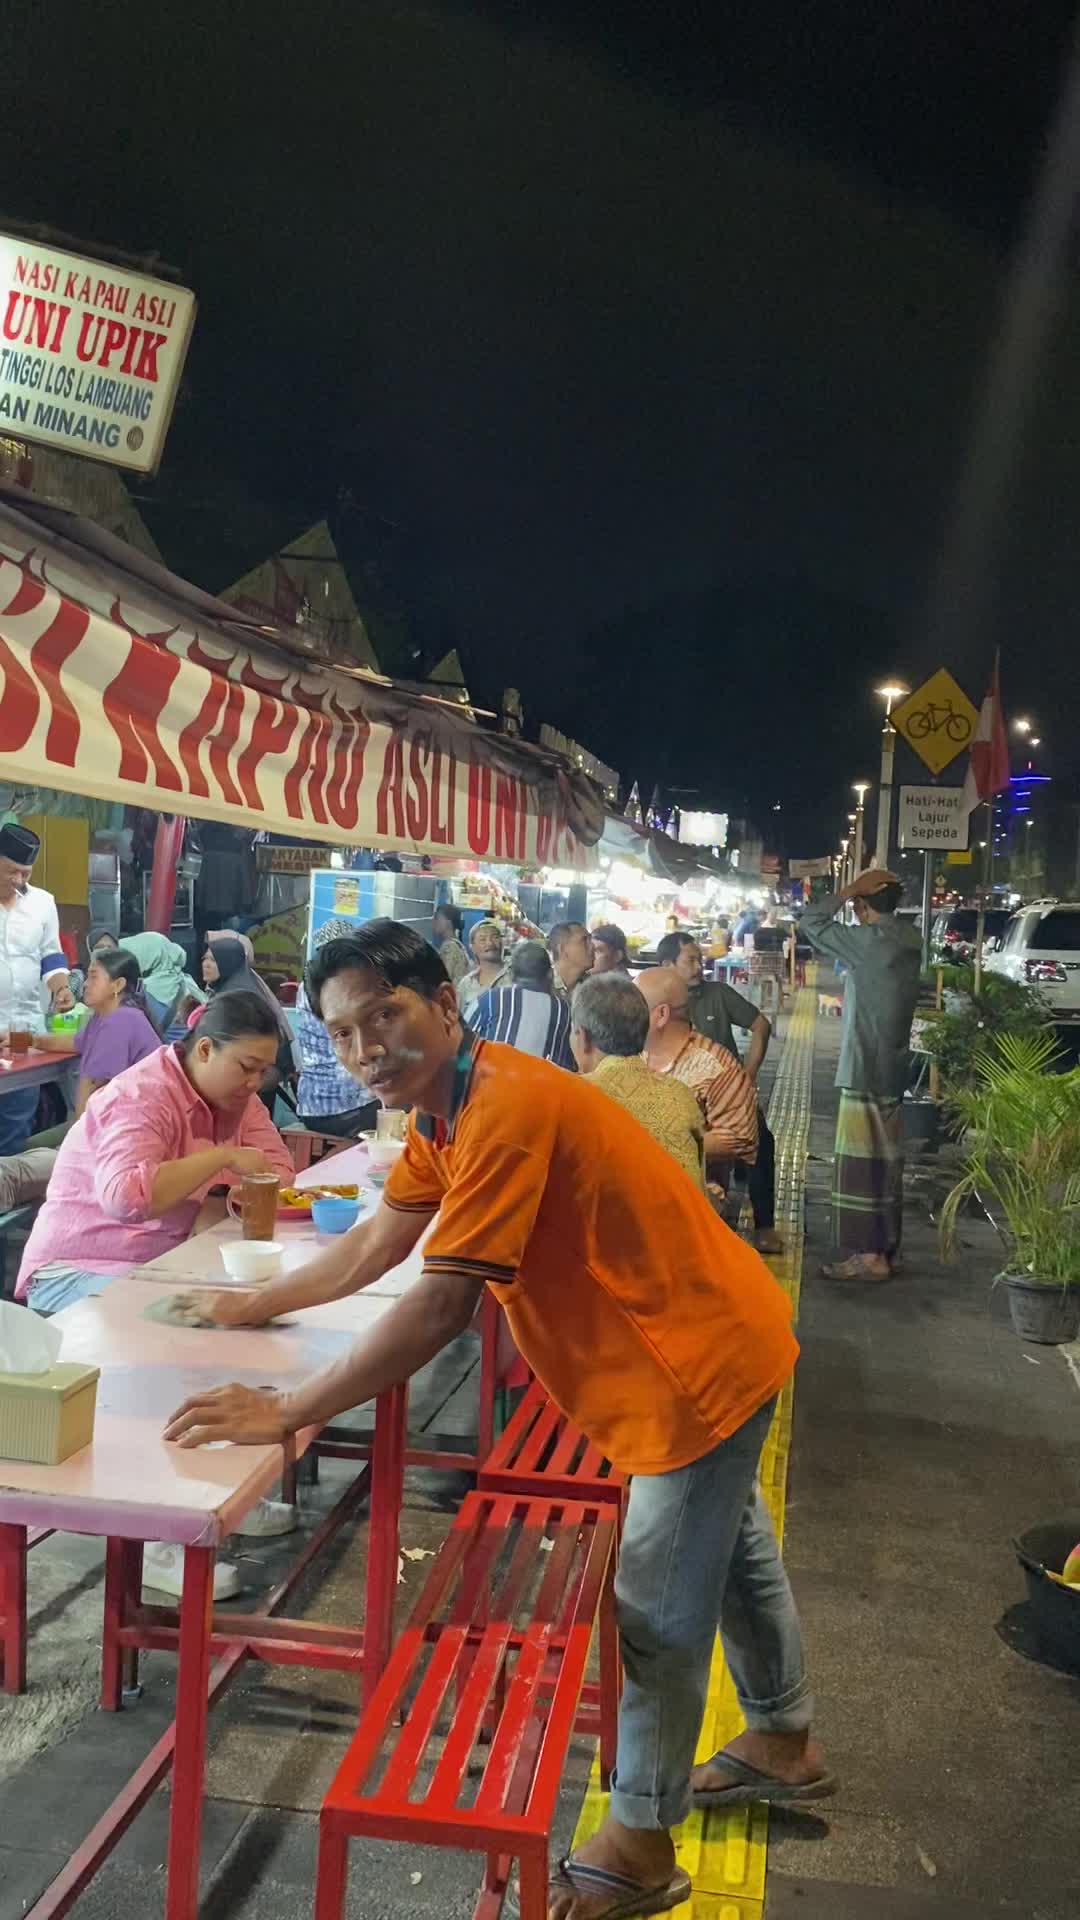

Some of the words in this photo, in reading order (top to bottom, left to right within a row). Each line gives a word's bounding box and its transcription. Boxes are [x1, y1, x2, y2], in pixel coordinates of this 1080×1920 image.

[15, 255, 61, 293] NASI
[64, 271, 130, 314] KAPAU
[132, 292, 176, 328] ASLI
[2, 290, 72, 354] UNI
[76, 312, 168, 383] UPIK
[44, 360, 75, 398] LOS
[75, 371, 153, 421] LAMBUANG
[33, 402, 121, 448] MINANG
[103, 593, 371, 829] KAPAU
[376, 724, 457, 845] ASLI
[467, 745, 528, 860] UNI
[905, 794, 959, 808] Hati-Hat
[918, 811, 949, 825] Lajur
[911, 826, 958, 840] Sepeda
